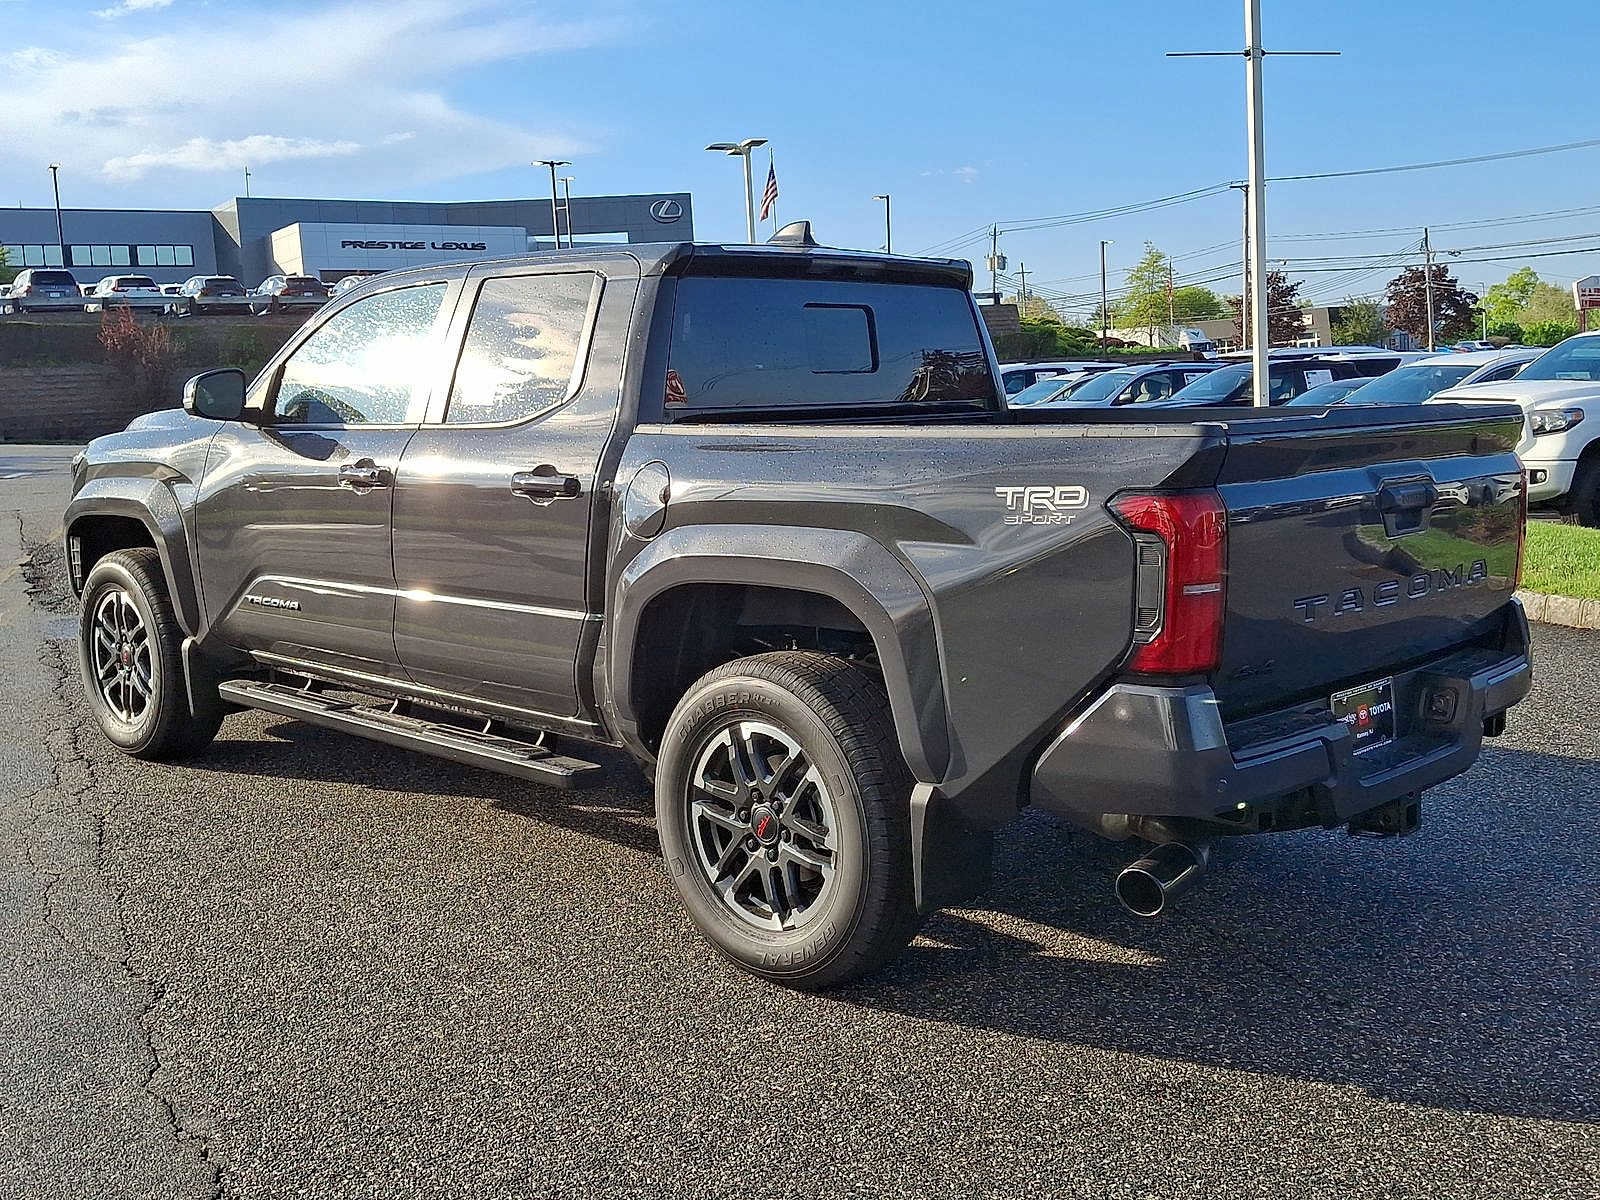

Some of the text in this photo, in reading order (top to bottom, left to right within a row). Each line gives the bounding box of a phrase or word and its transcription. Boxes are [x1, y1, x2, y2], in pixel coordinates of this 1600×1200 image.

[341, 240, 487, 251] PRESTIGE LEXUS
[994, 485, 1090, 513] TRD
[1003, 513, 1077, 526] SPORT
[1292, 558, 1489, 623] TACOMA
[245, 594, 301, 611] TACOMA
[679, 691, 752, 744] GRABBER
[1369, 701, 1392, 717] TOYOTA
[760, 921, 838, 967] GENERAL
